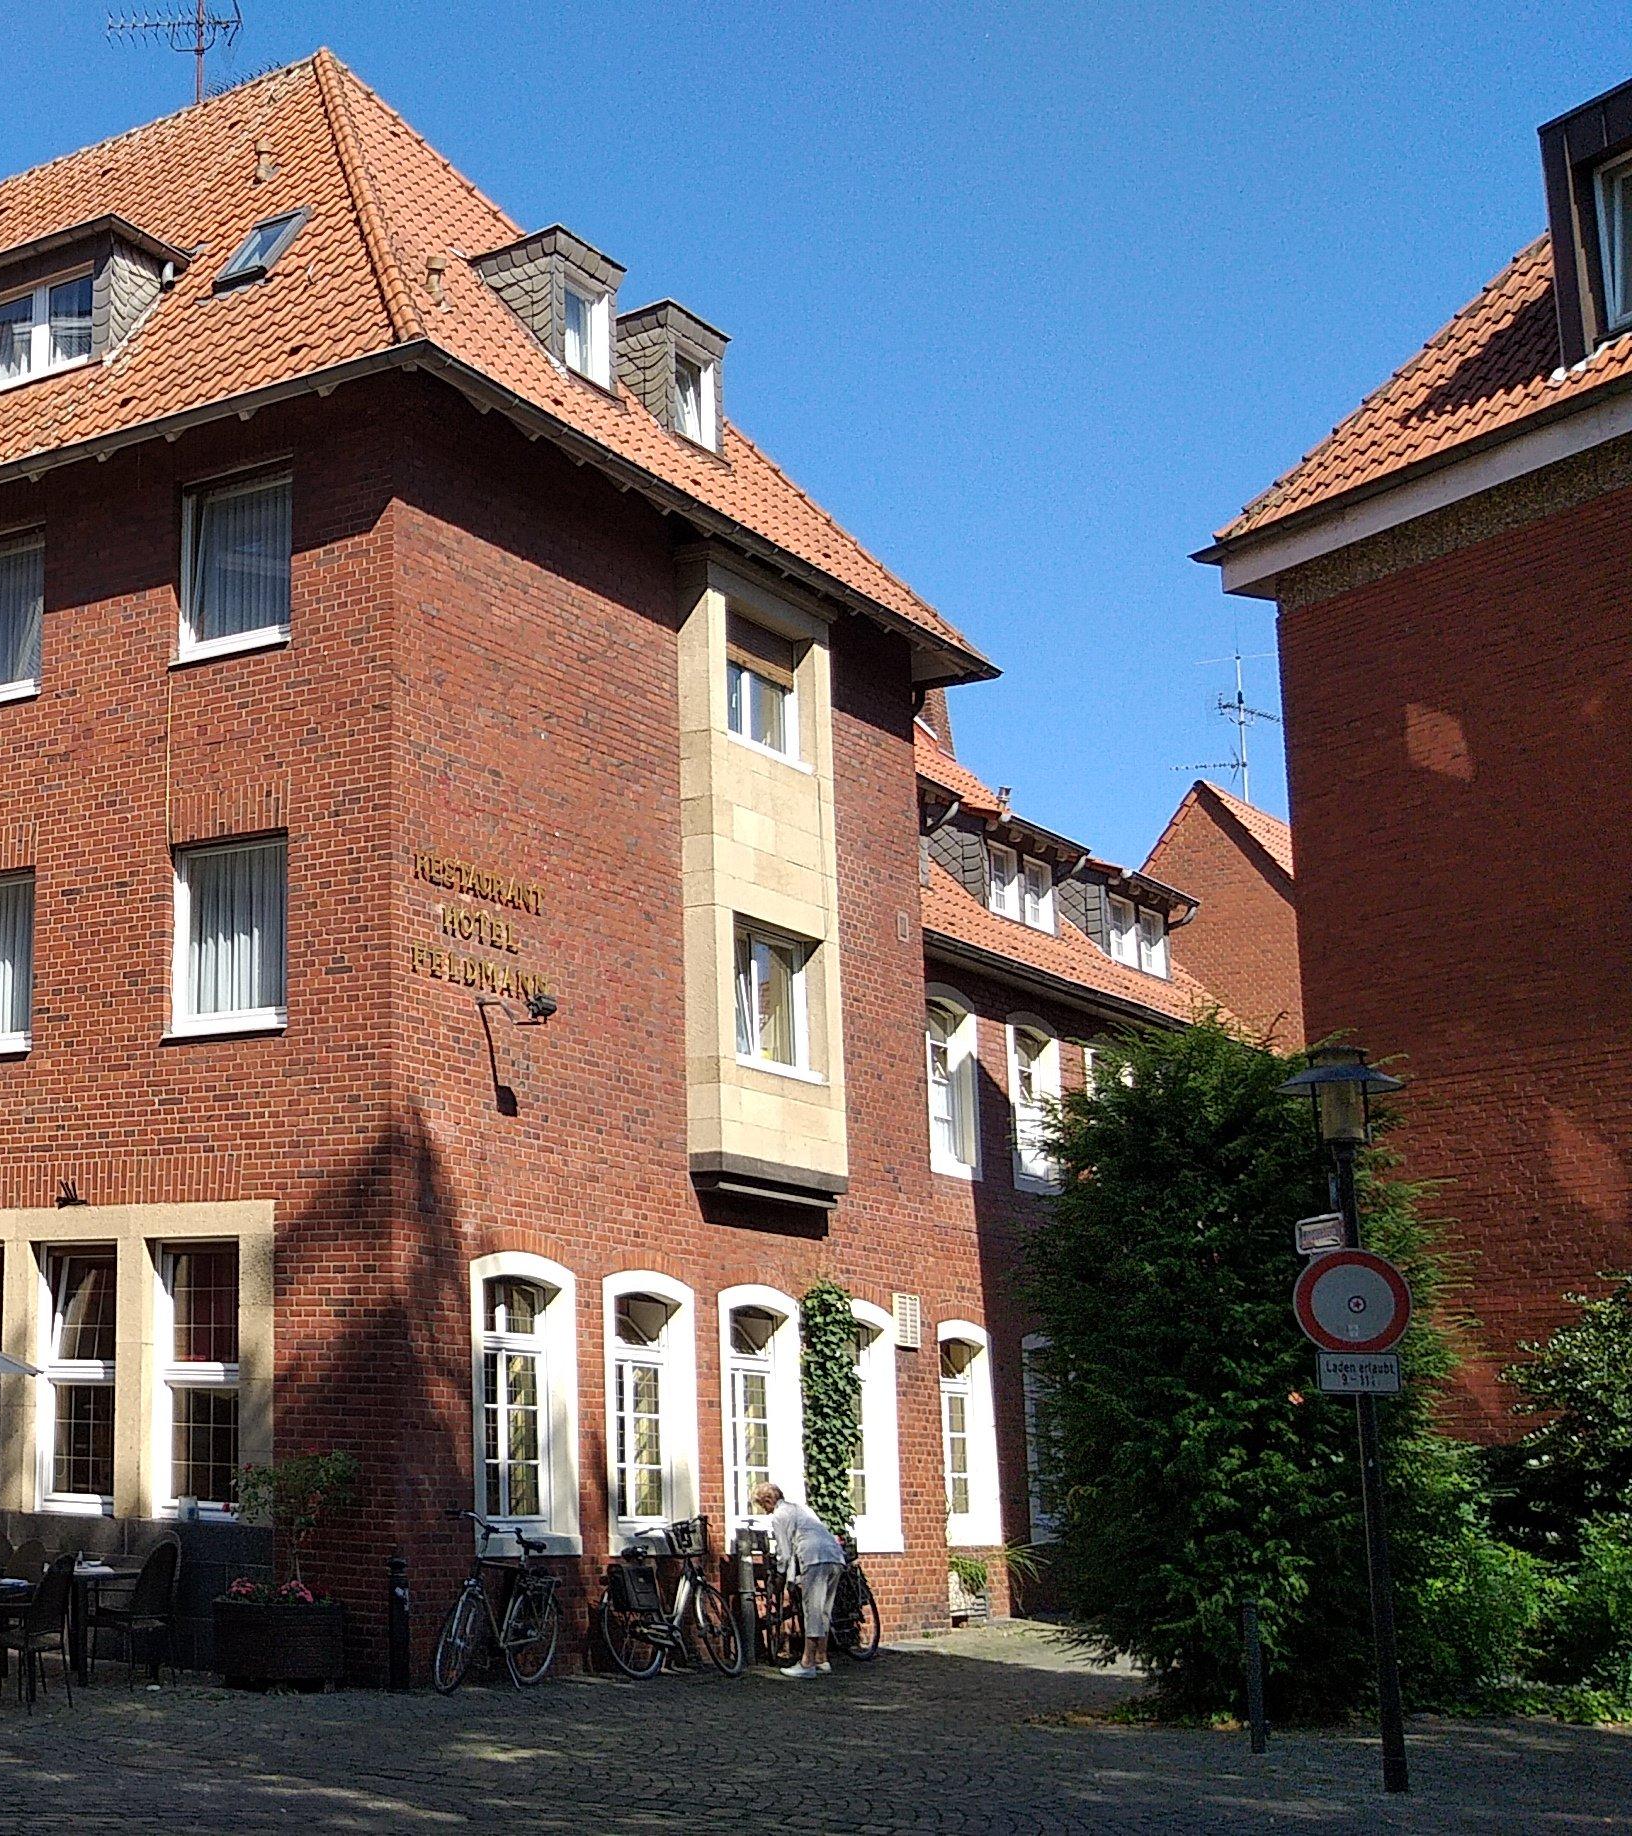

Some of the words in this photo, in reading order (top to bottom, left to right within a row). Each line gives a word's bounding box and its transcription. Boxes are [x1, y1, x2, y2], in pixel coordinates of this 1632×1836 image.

[413, 851, 546, 916] RESTAURANT
[439, 903, 519, 955] HOTEL
[410, 940, 550, 1001] FELDMANN
[1325, 1360, 1356, 1373] Laden
[1359, 1362, 1396, 1375] erlaubt
